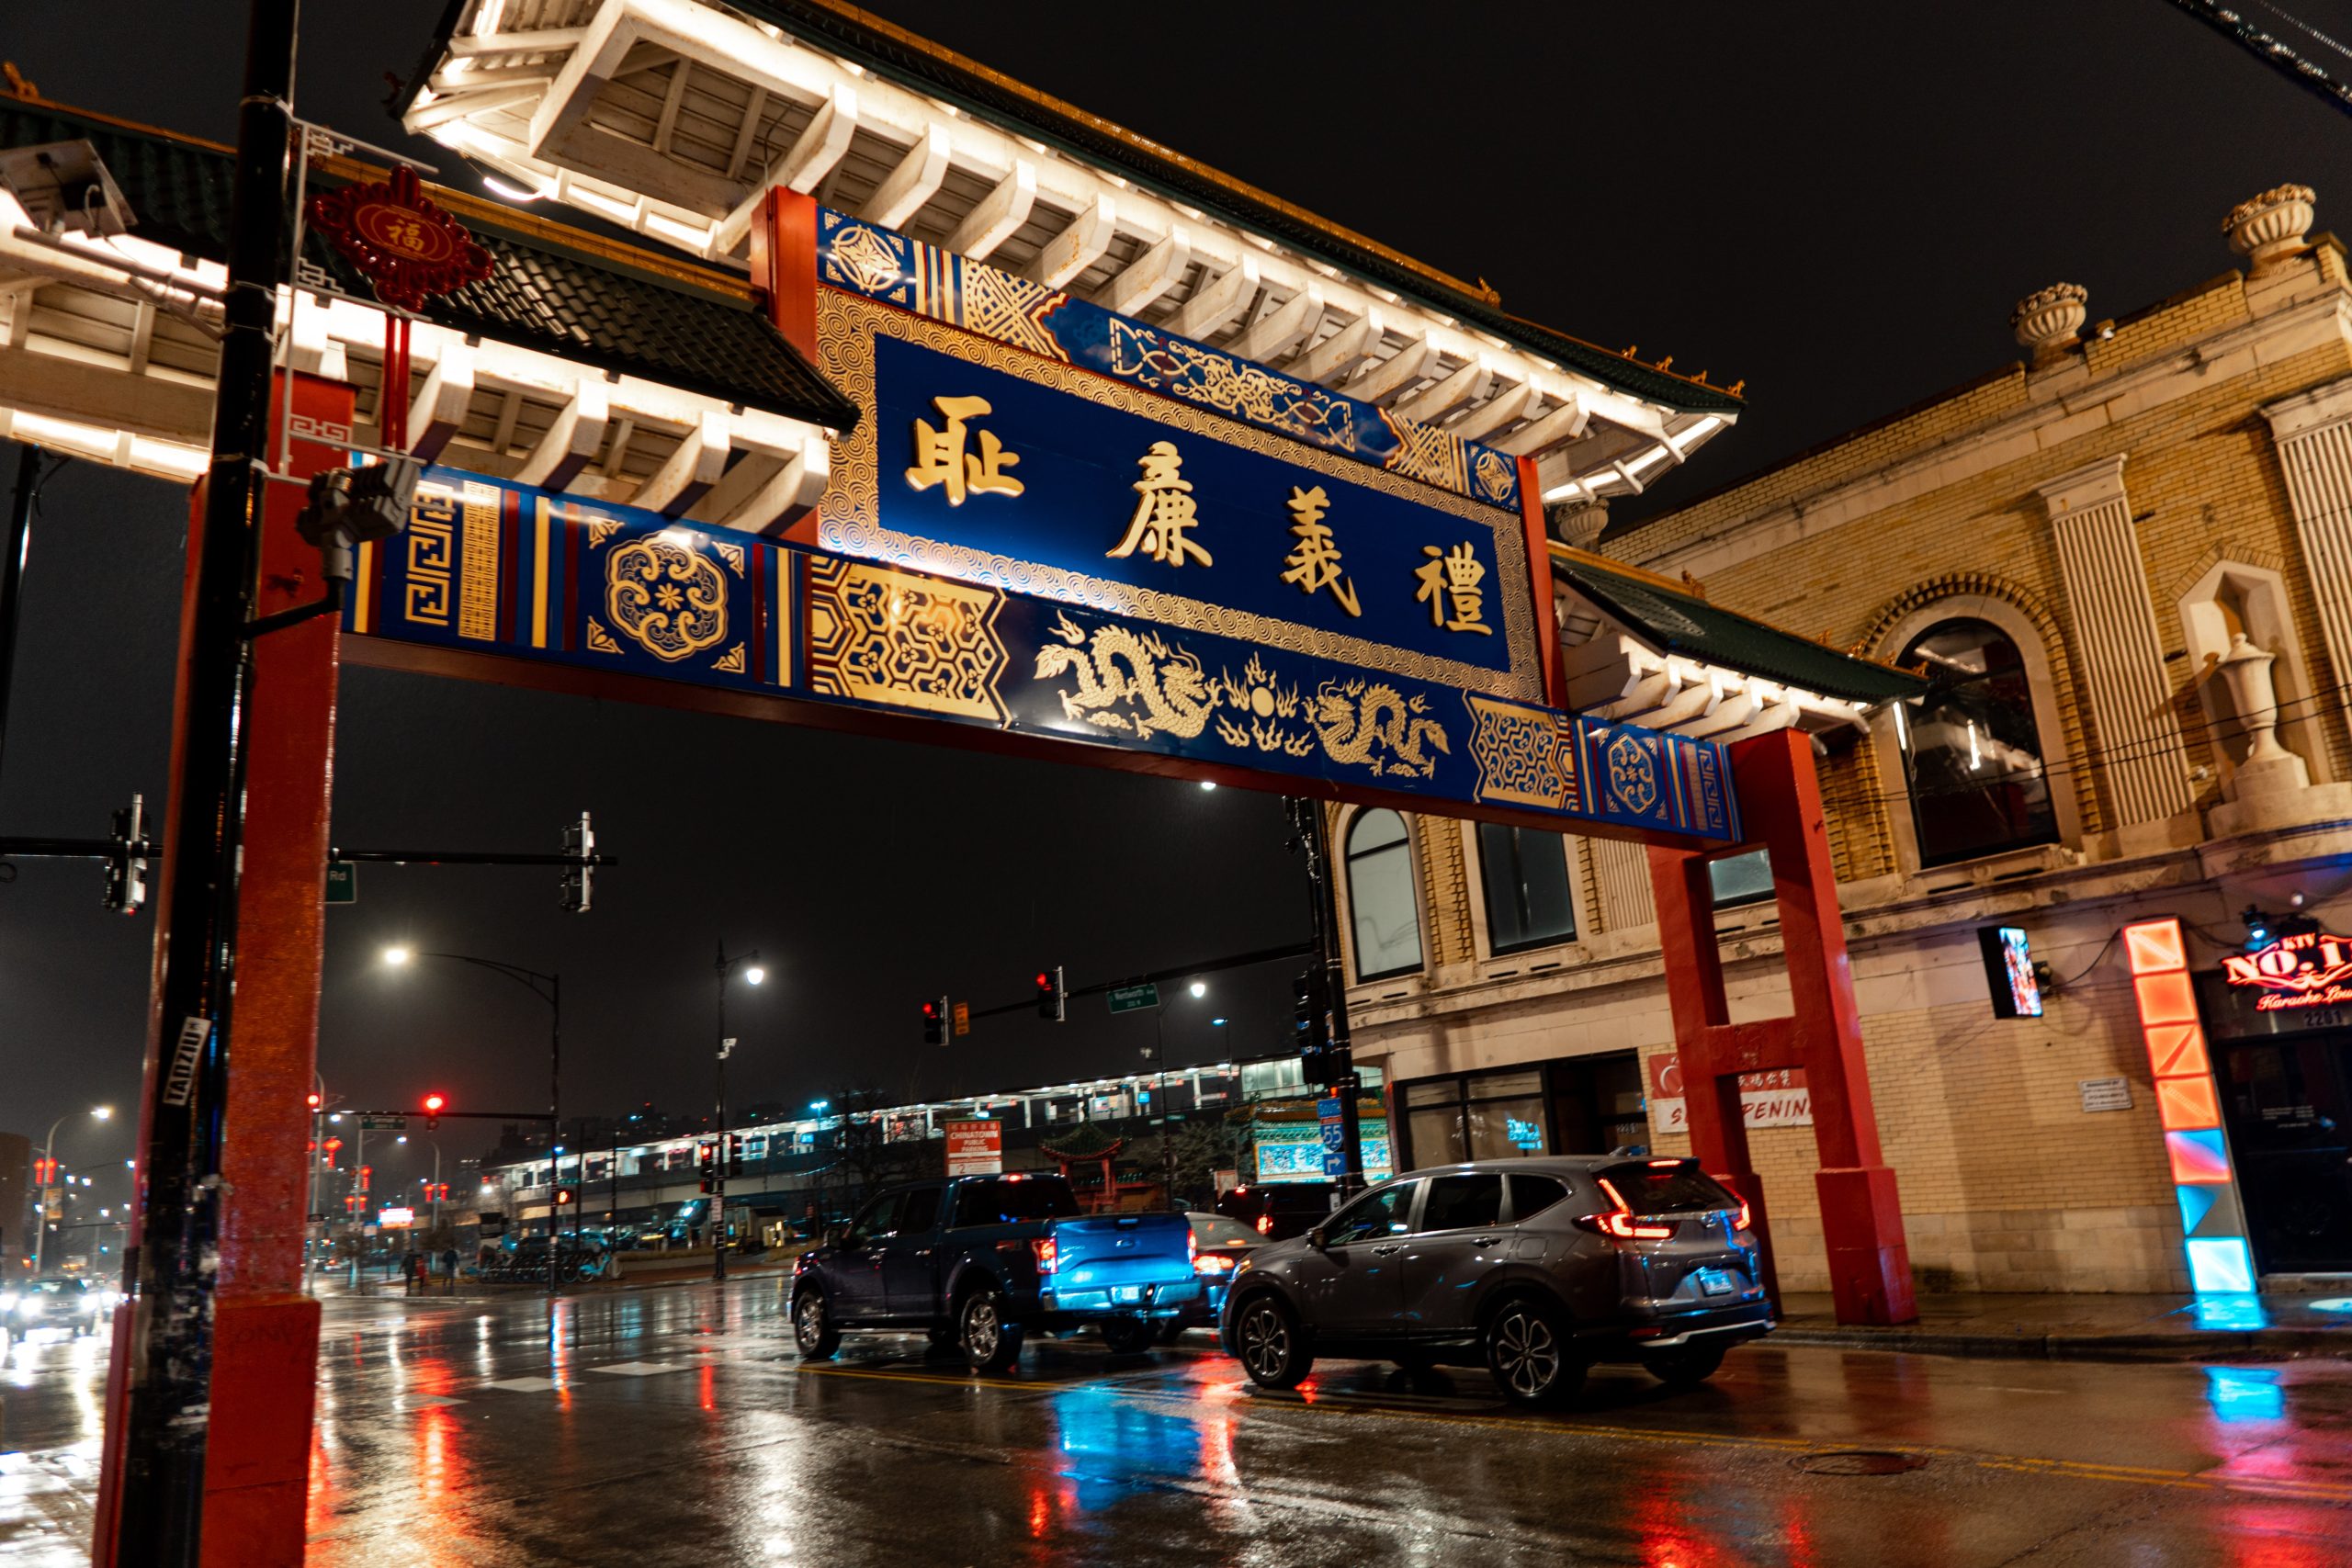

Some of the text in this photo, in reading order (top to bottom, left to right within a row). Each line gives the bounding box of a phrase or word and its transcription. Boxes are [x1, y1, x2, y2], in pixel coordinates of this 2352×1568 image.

[386, 219, 424, 251] 福
[328, 870, 346, 881] Rd
[2280, 933, 2314, 951] KTV
[2256, 990, 2323, 1011] Karaoke
[949, 1130, 999, 1140] CHINATOWN
[1323, 1124, 1343, 1145] 55
[961, 1145, 989, 1154] PARKING
